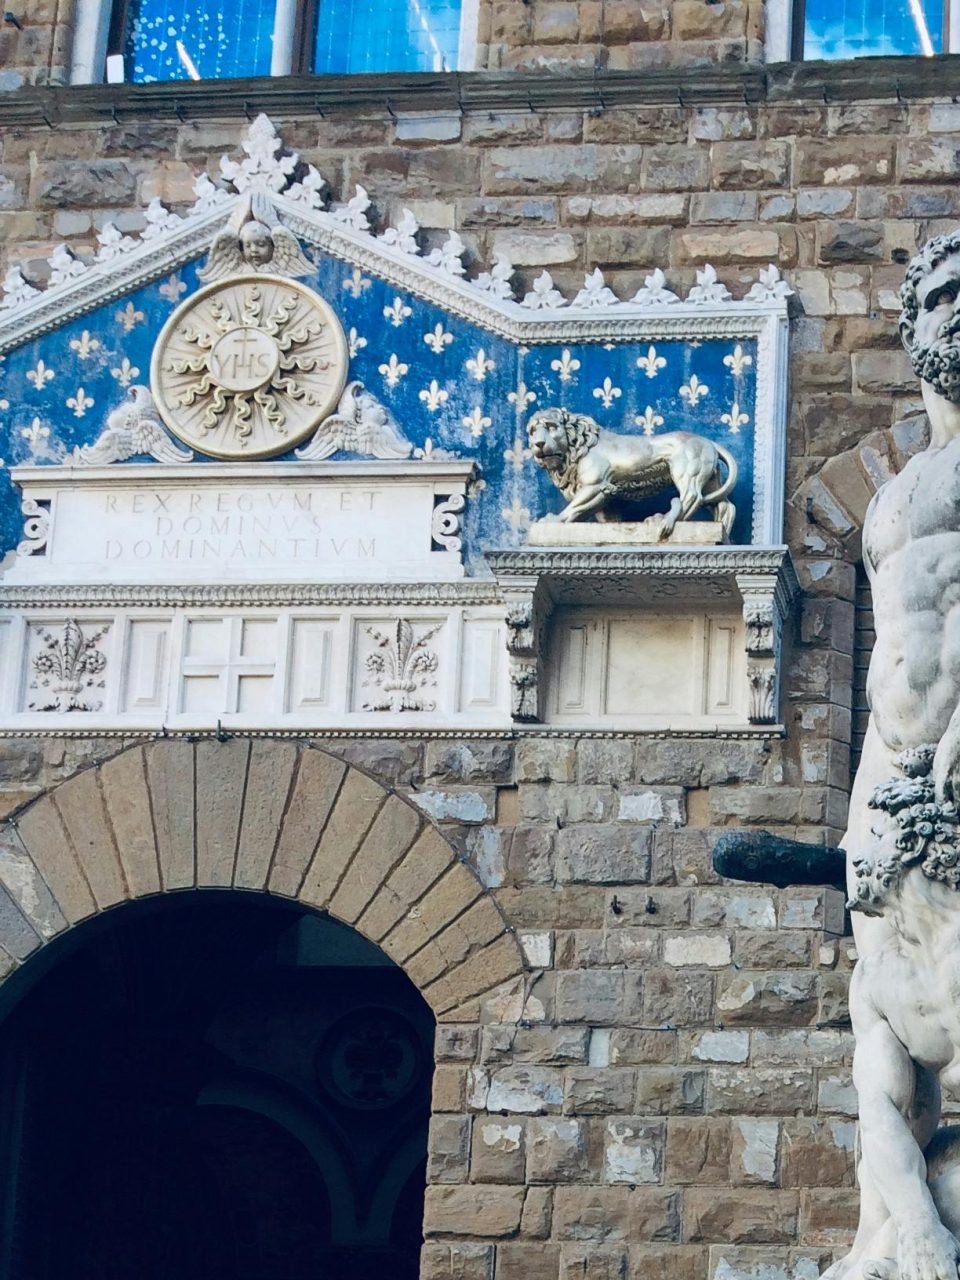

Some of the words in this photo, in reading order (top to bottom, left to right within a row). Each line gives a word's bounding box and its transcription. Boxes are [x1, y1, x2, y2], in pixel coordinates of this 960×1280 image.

[104, 494, 172, 513] REX
[189, 492, 312, 513] REGVM
[339, 491, 382, 512] ET
[156, 516, 322, 536] DOMINVS
[105, 538, 376, 559] DOMINANTIVM
